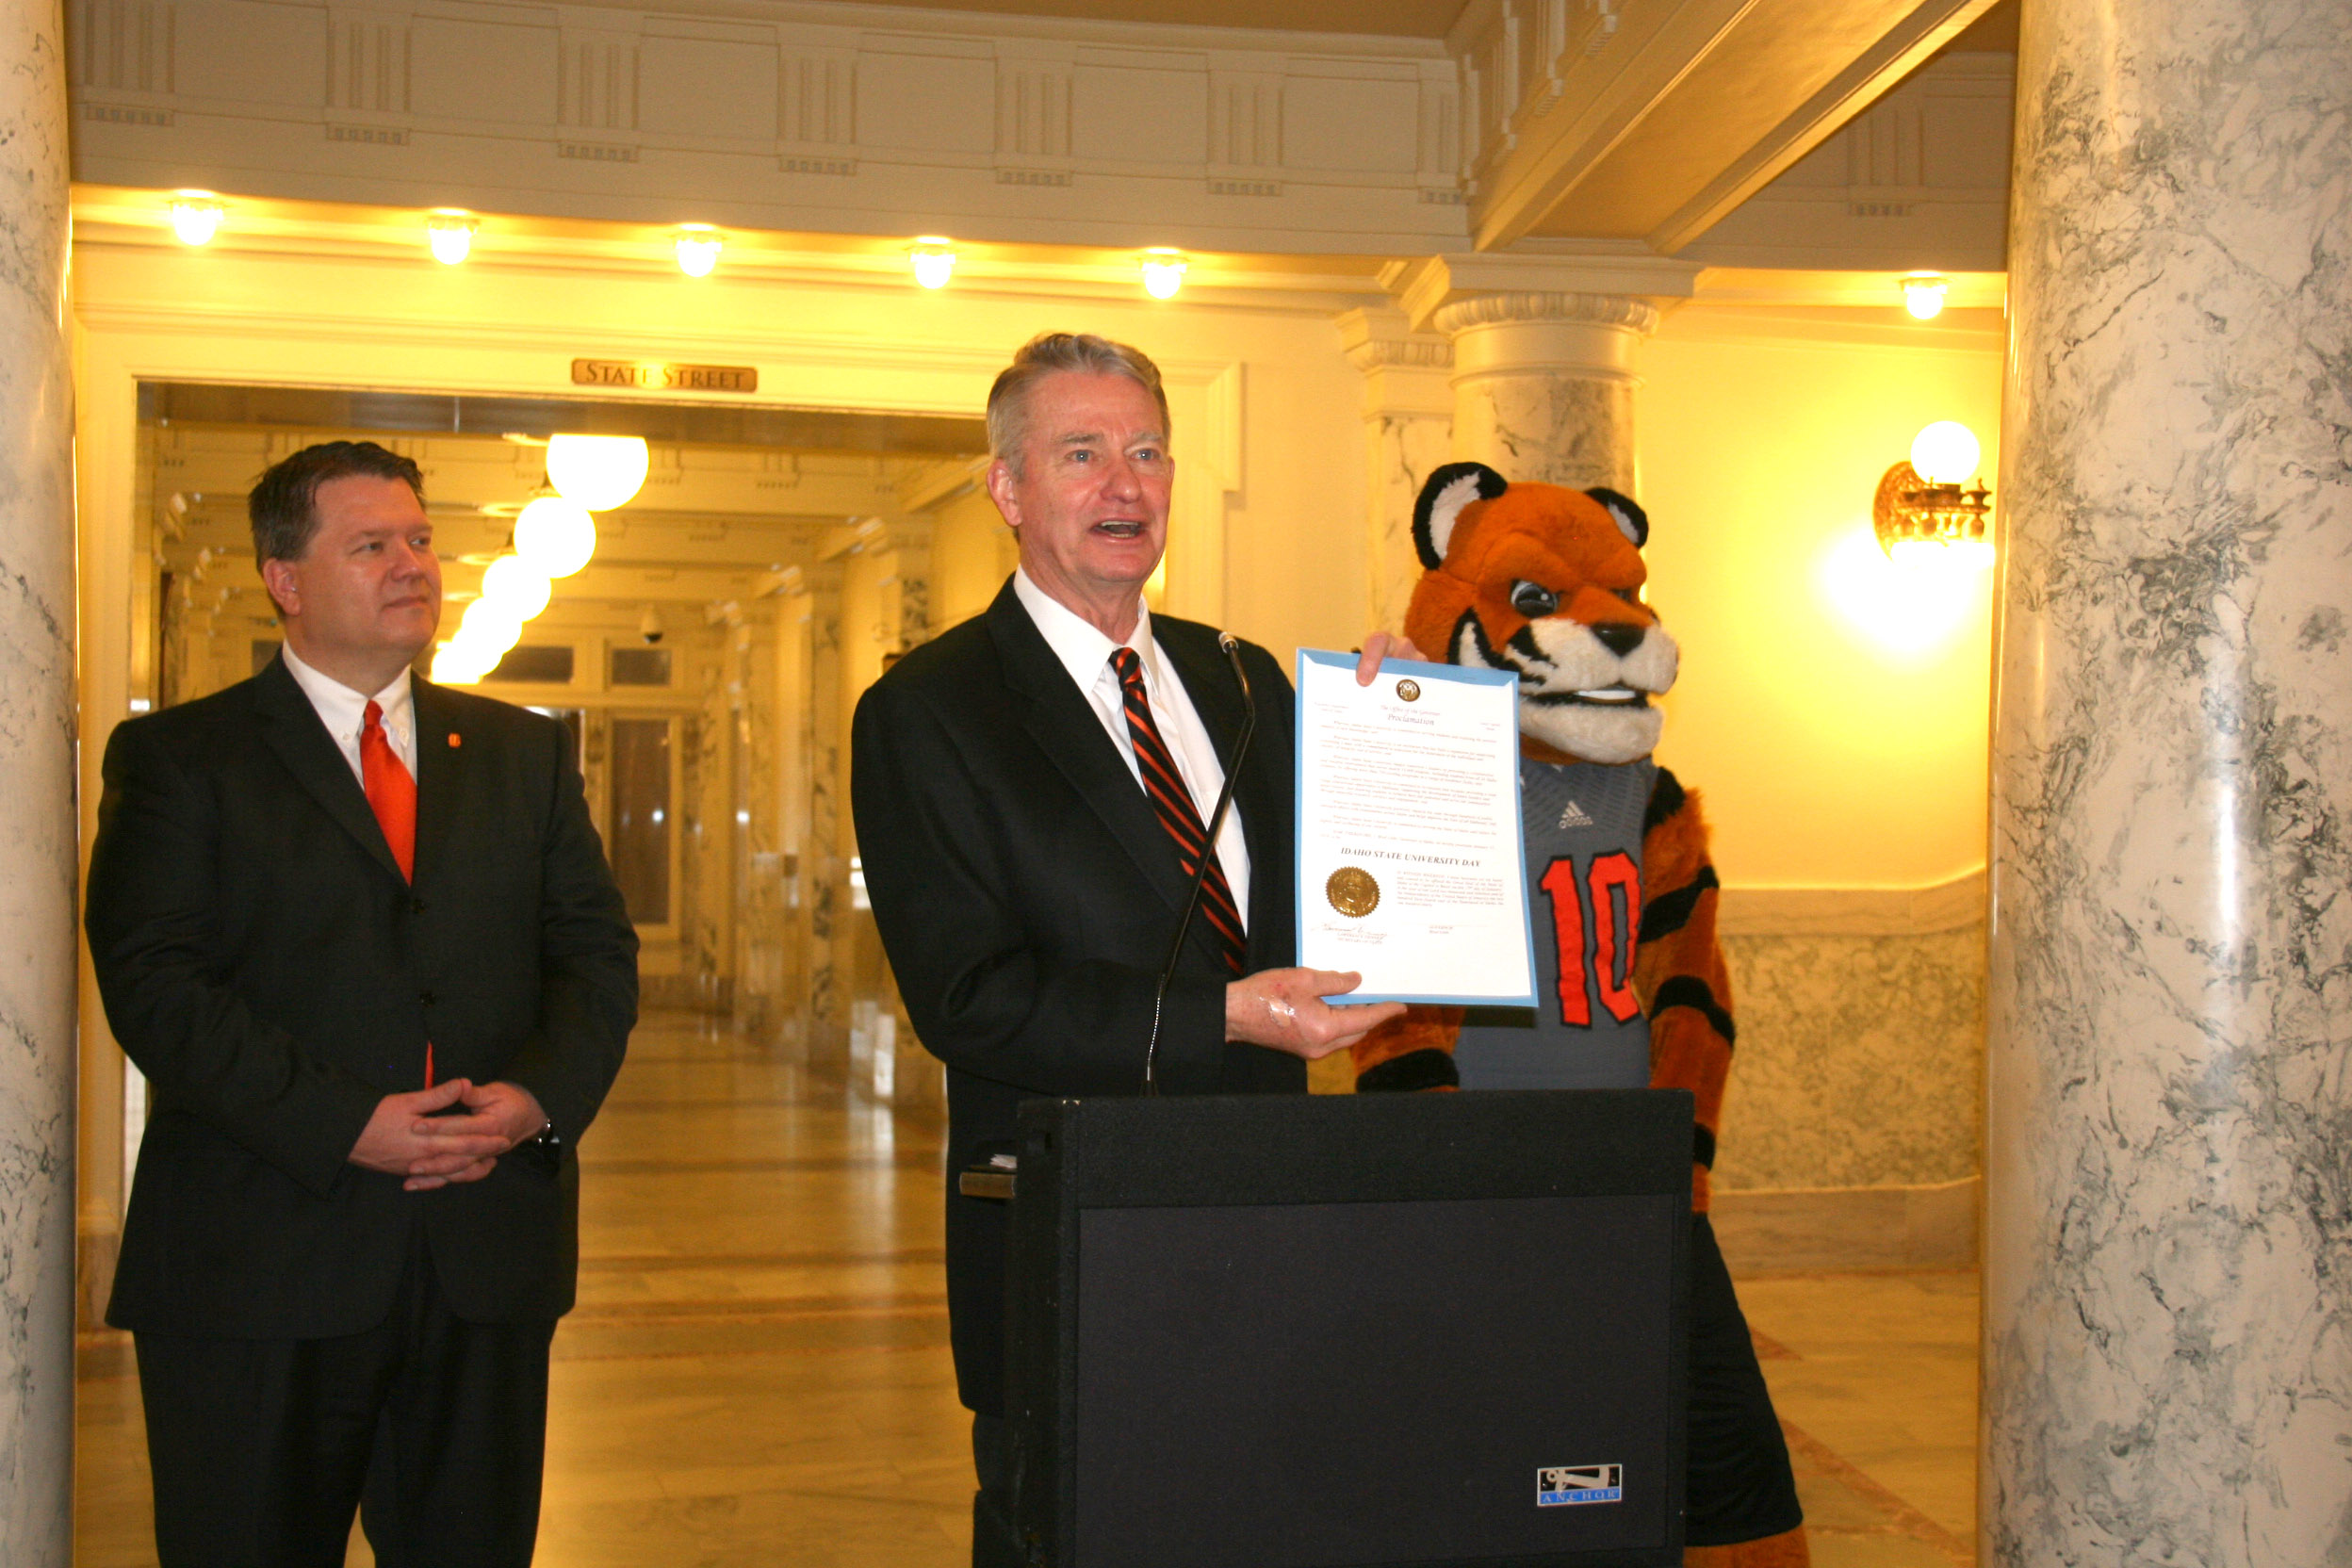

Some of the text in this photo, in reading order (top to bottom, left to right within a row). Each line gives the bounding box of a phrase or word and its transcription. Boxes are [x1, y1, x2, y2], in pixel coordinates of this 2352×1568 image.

[663, 368, 744, 389] STREET
[1387, 713, 1434, 726] Proclamation
[1560, 816, 1592, 829] adidas
[1341, 847, 1481, 867] IDAHO STATE UNIVERSITY DAY
[1538, 849, 1642, 1029] 10
[1543, 1490, 1615, 1503] ANCHOR
